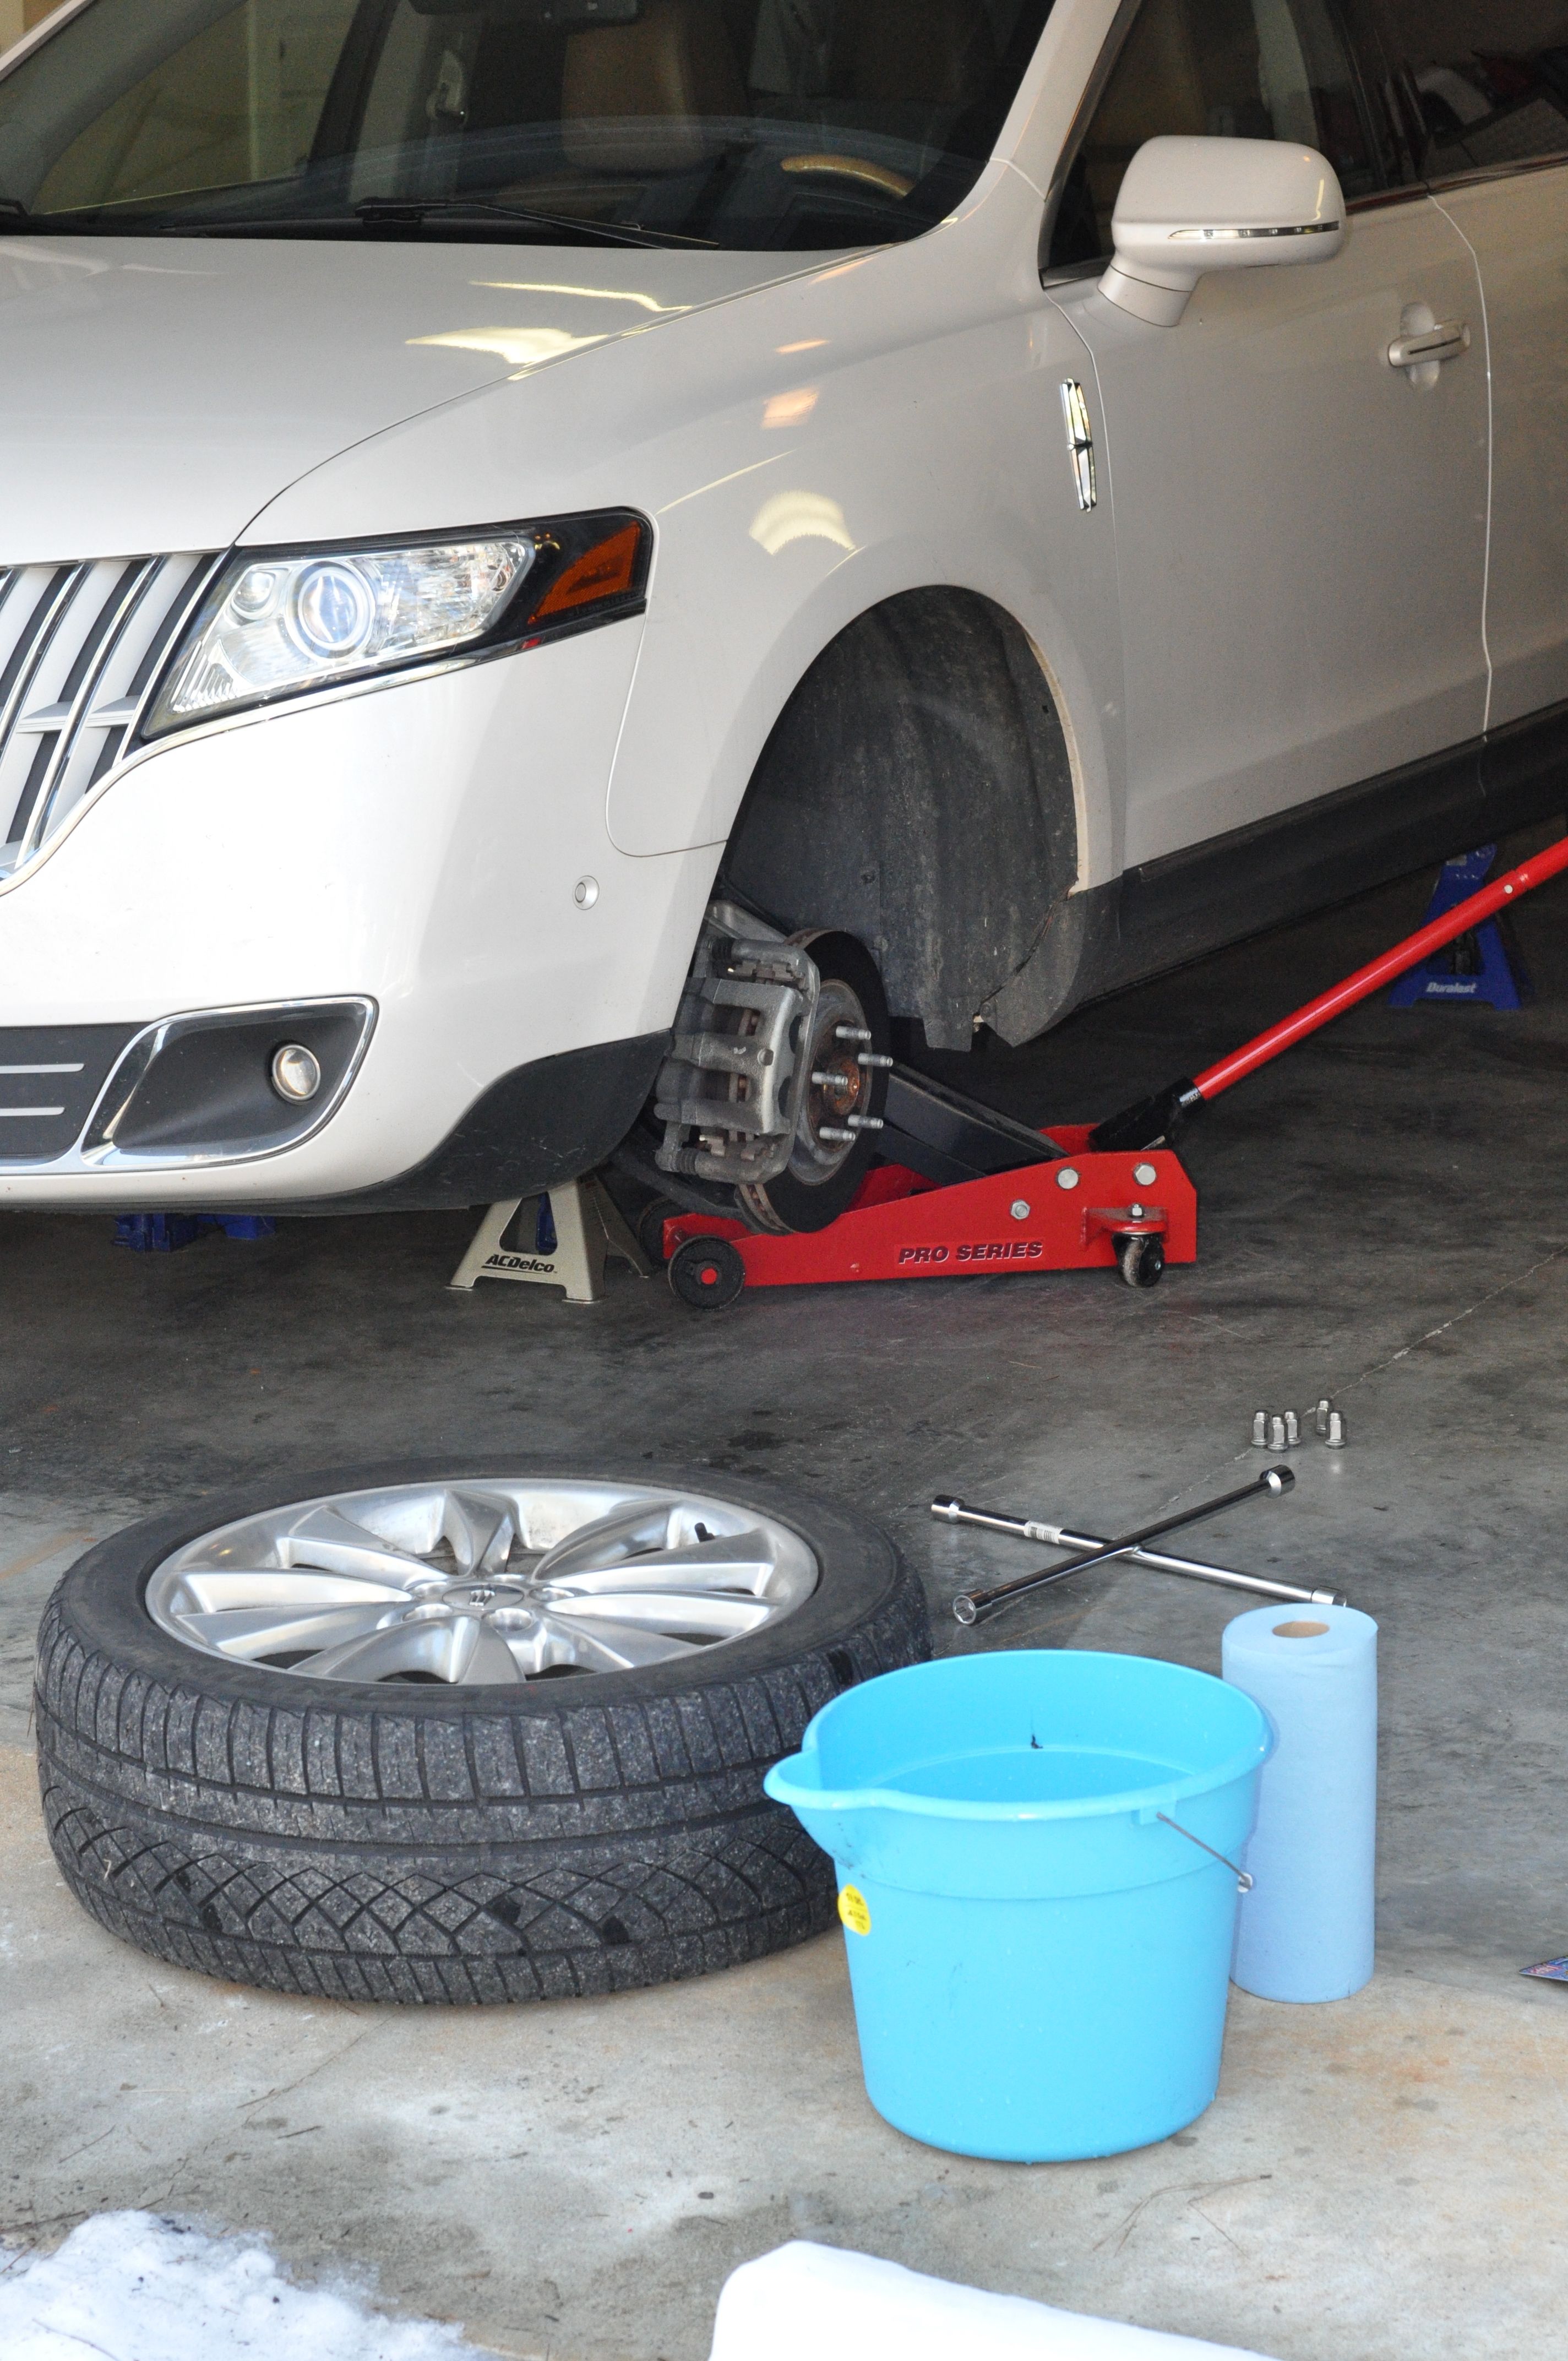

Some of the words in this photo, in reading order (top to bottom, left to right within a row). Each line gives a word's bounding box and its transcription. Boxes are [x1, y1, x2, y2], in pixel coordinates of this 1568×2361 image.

[899, 1246, 949, 1264] PRO
[956, 1241, 1043, 1261] SERIES
[485, 1254, 555, 1273] ACDelco
